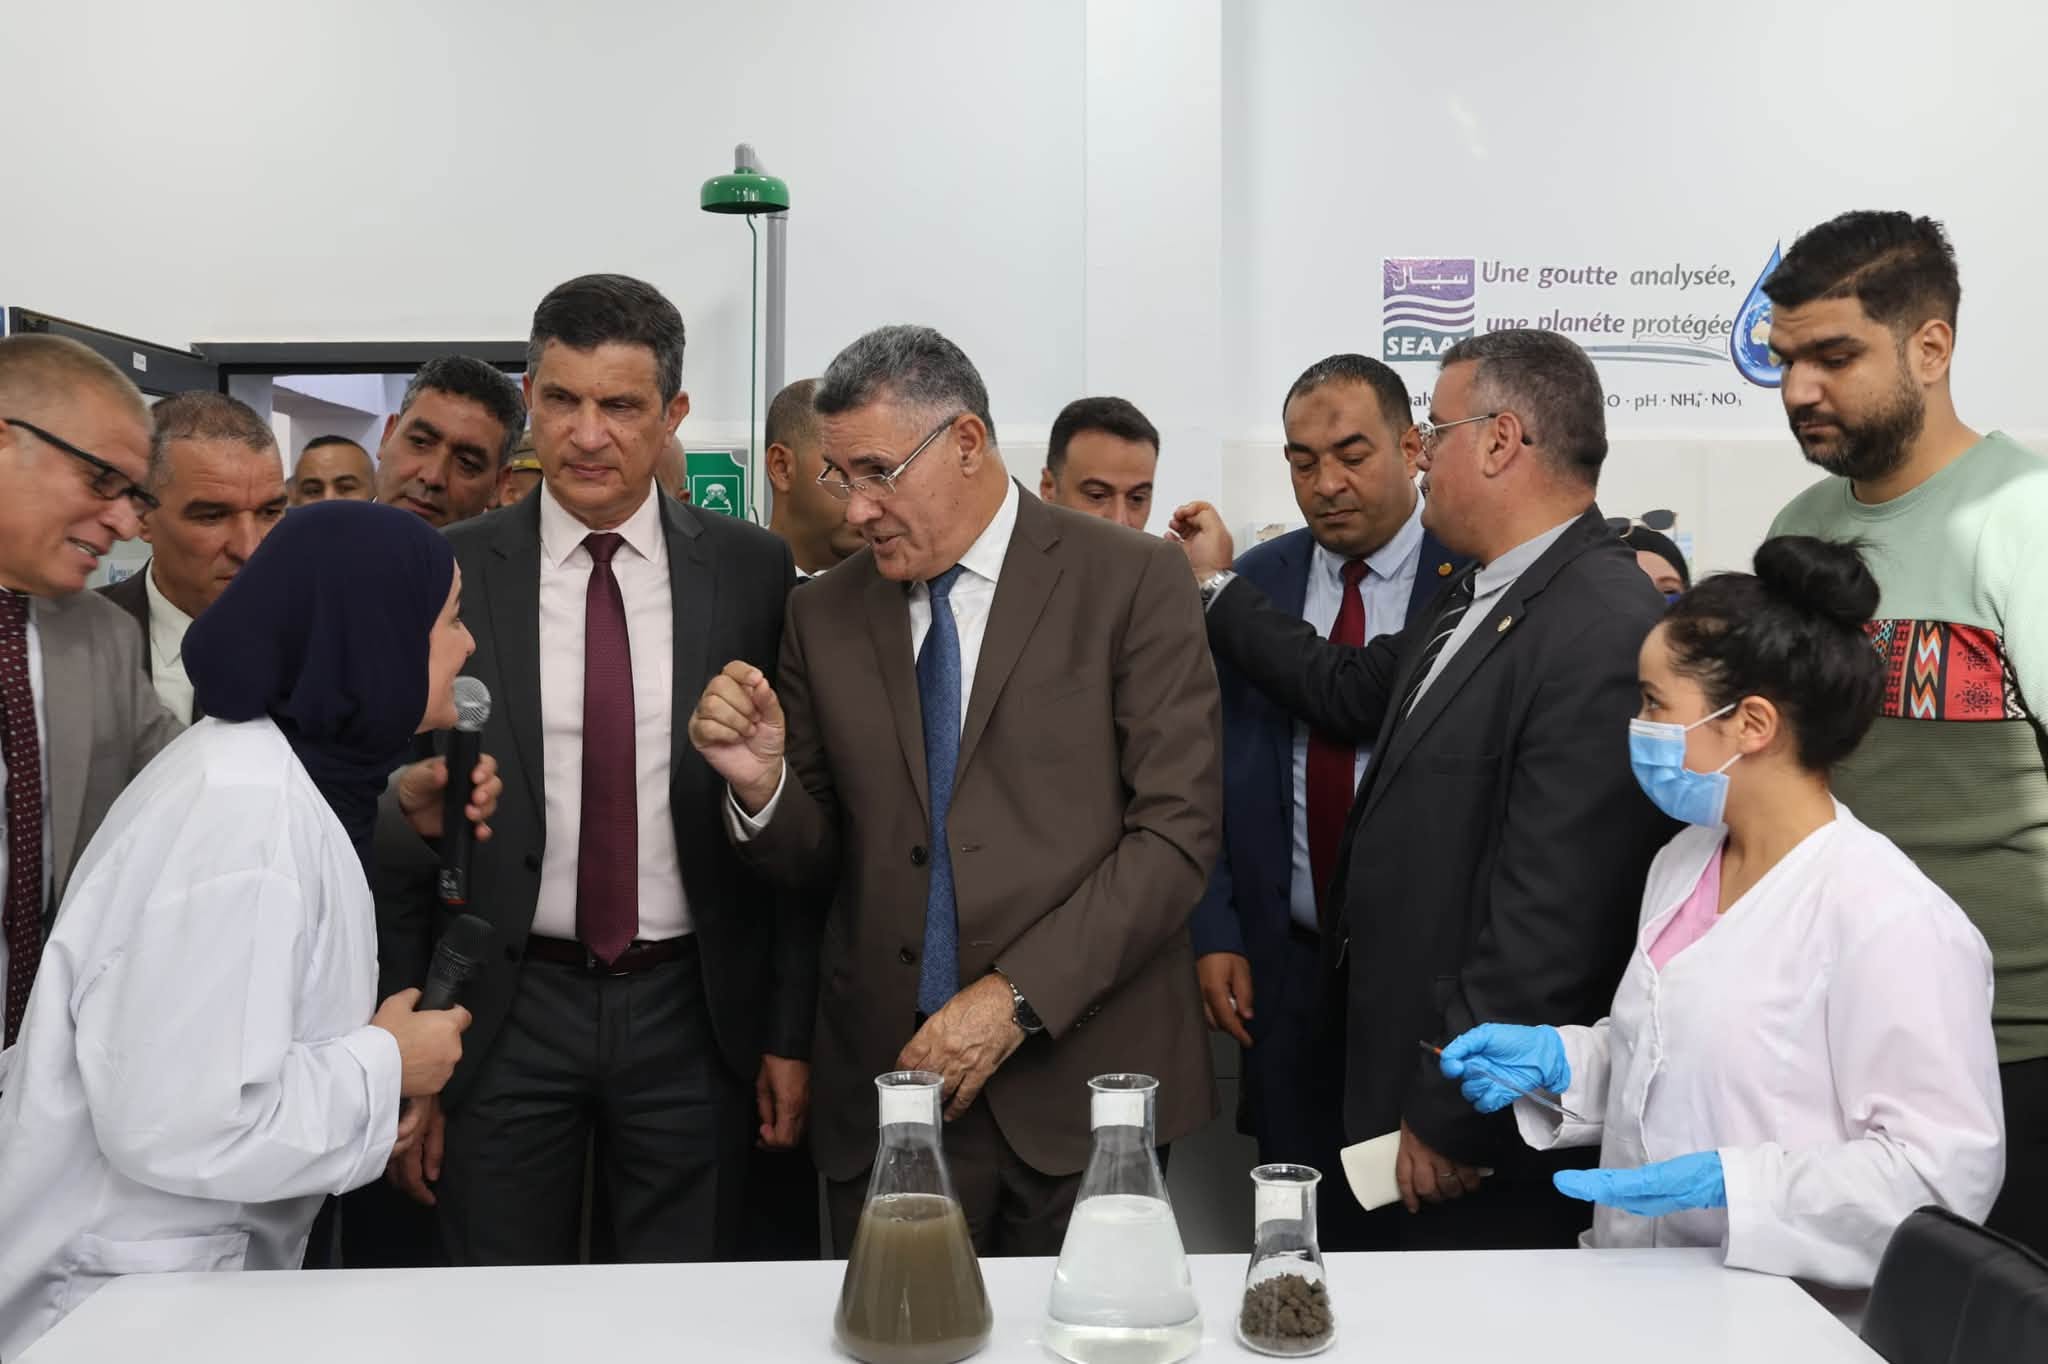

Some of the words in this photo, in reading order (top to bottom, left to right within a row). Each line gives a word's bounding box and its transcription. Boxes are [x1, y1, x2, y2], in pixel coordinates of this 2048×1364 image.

[1391, 266, 1468, 291] سيال
[1482, 261, 1529, 283] Une
[1538, 265, 1618, 289] goutte
[1630, 263, 1735, 291] analysée,
[1486, 317, 1529, 333] une
[1537, 309, 1625, 333] planéte
[1632, 313, 1733, 340] protégée
[1386, 336, 1467, 355] SEAA
[1634, 393, 1657, 411] pH
